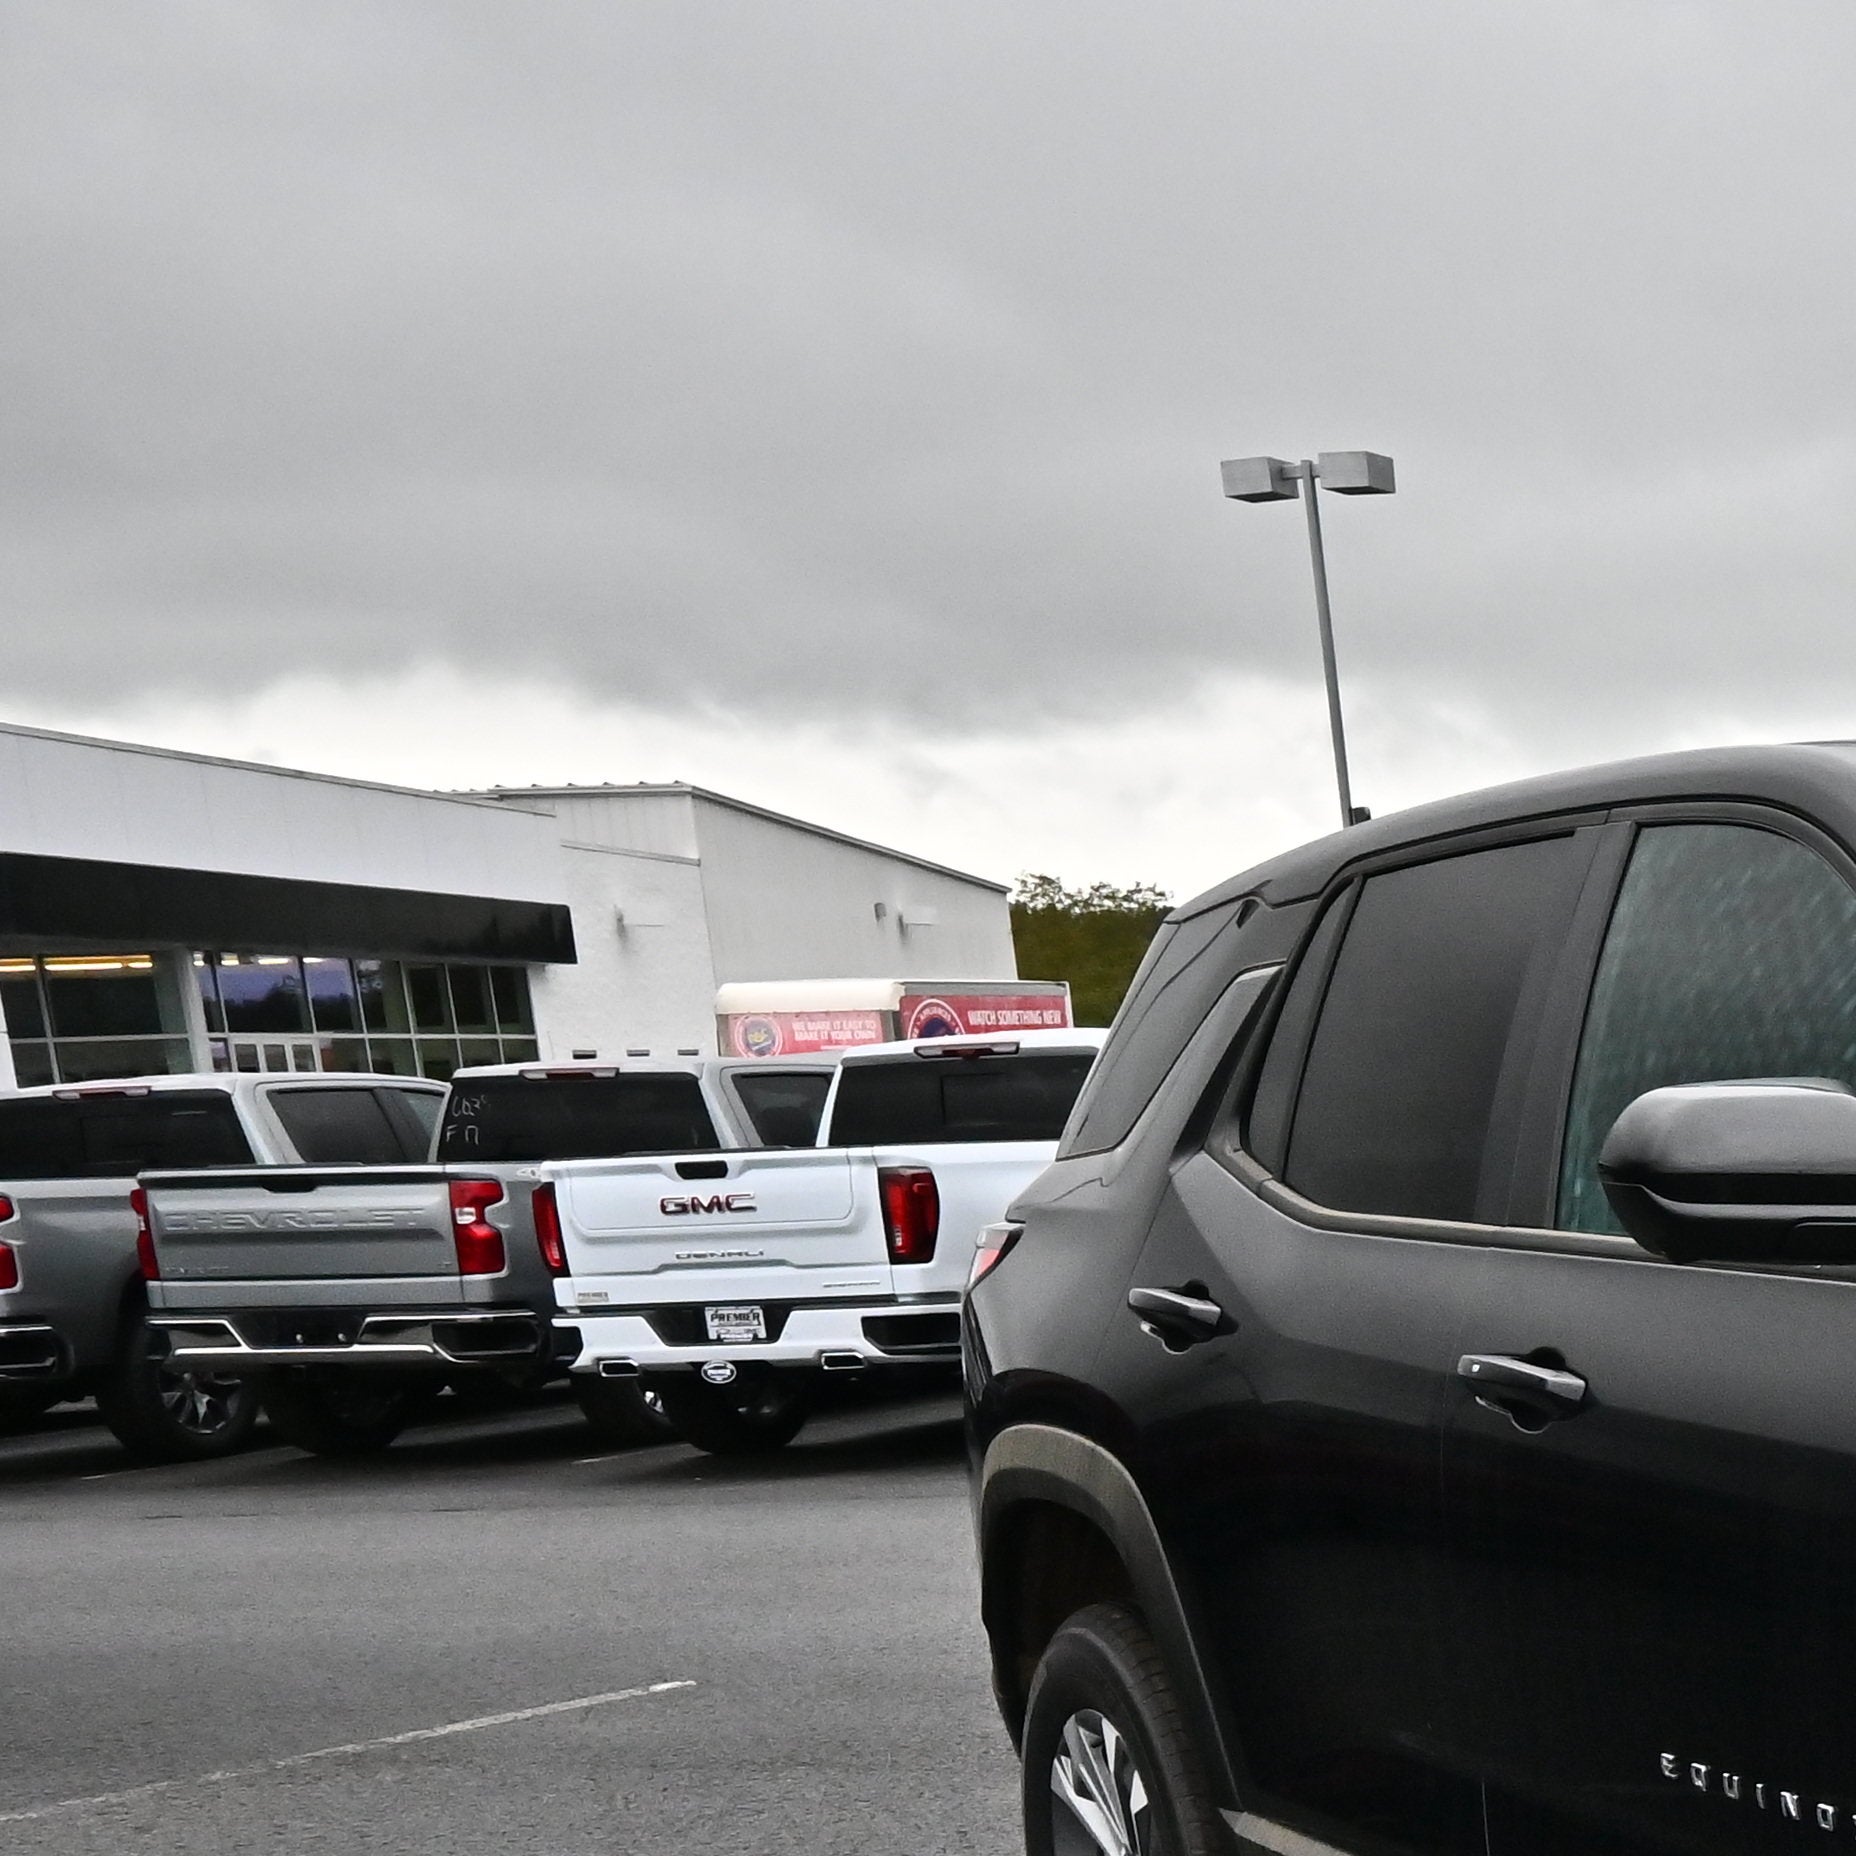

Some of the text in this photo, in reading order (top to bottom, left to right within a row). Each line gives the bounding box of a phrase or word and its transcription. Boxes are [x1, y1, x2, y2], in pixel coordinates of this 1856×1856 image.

[967, 1010, 996, 1025] WATCH
[998, 1010, 1042, 1025] SOMETHING
[659, 1193, 757, 1216] GMC
[164, 1206, 427, 1232] CHEVROLET
[675, 1249, 764, 1260] DENALI
[710, 1312, 762, 1326] PREMIER
